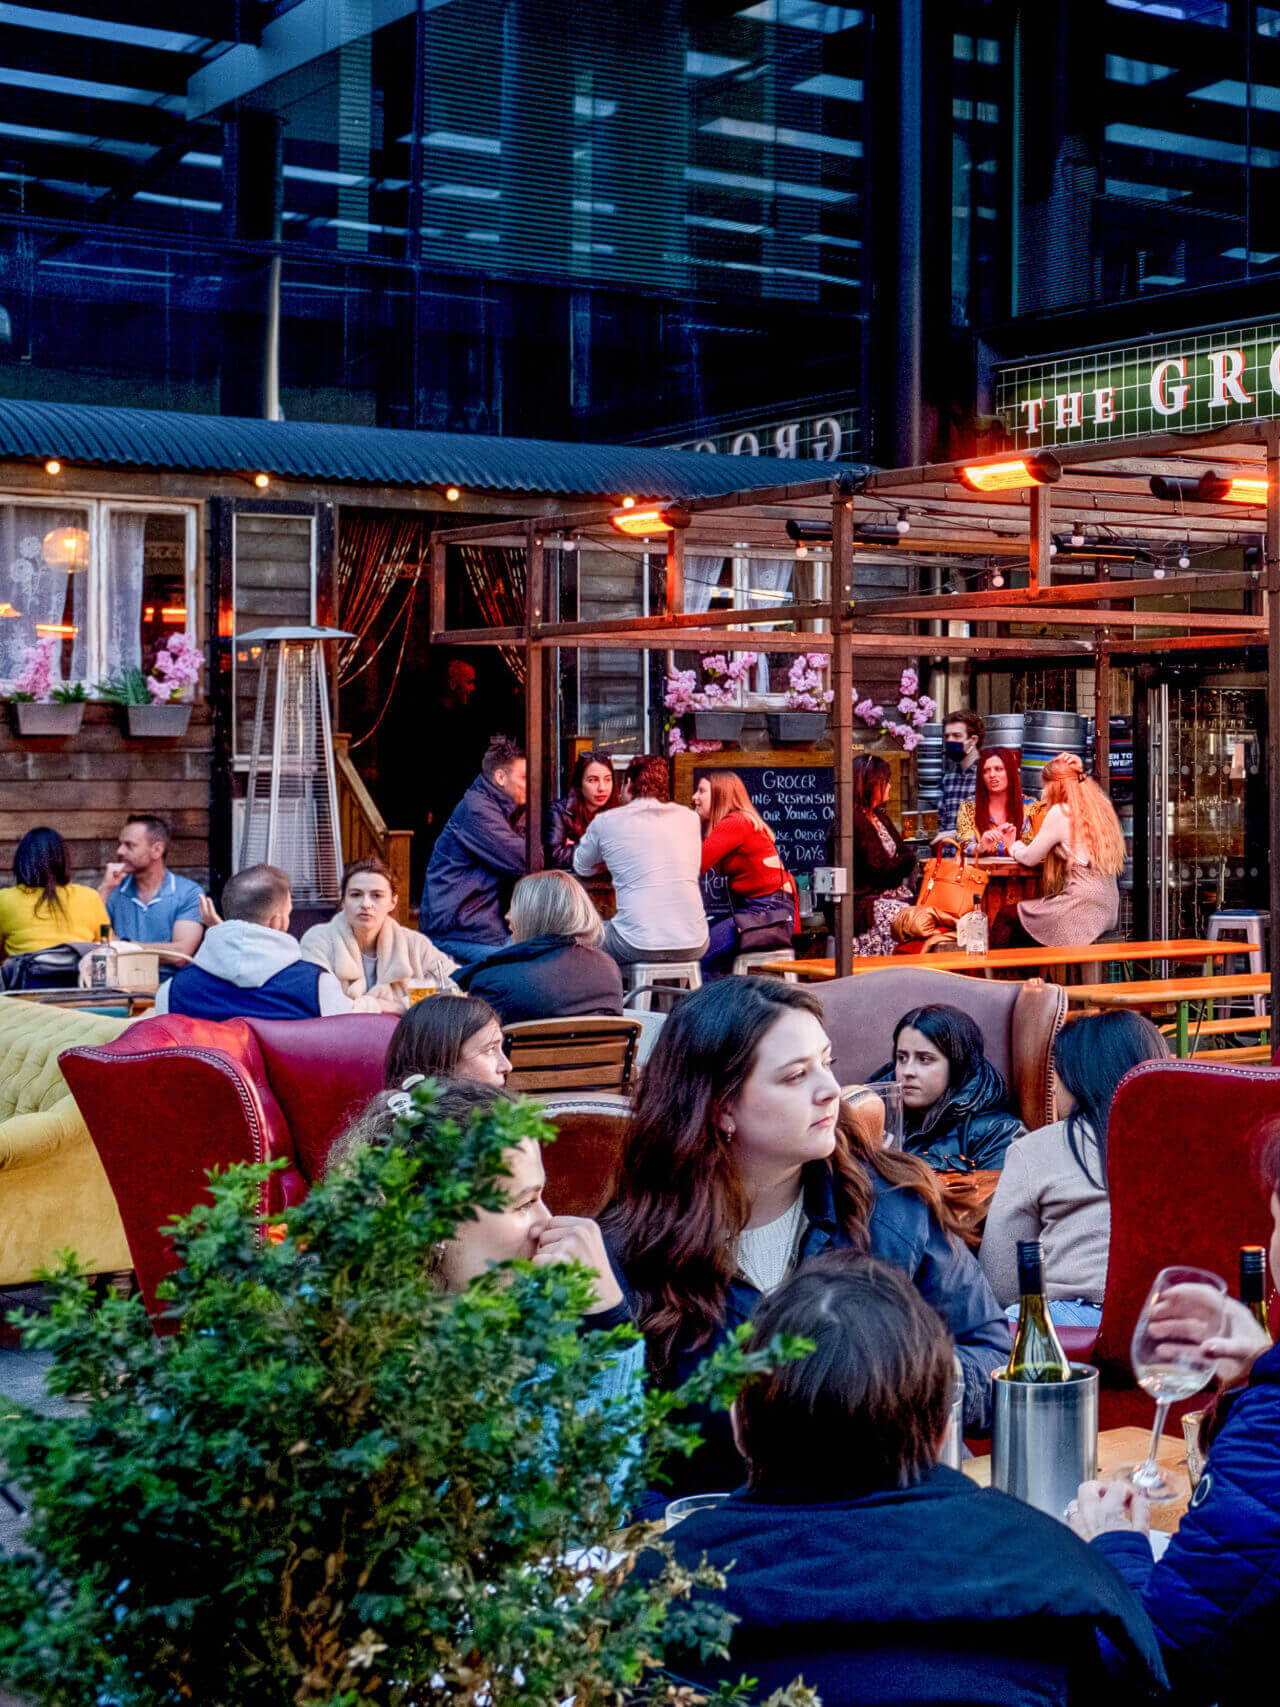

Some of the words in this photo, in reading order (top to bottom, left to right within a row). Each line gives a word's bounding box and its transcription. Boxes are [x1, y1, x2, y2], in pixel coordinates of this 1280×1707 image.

[1021, 385, 1116, 433] THE
[762, 770, 816, 789] GROCER
[752, 793, 771, 806] ING
[763, 810, 781, 821] OUR
[794, 844, 825, 861] DAYS
